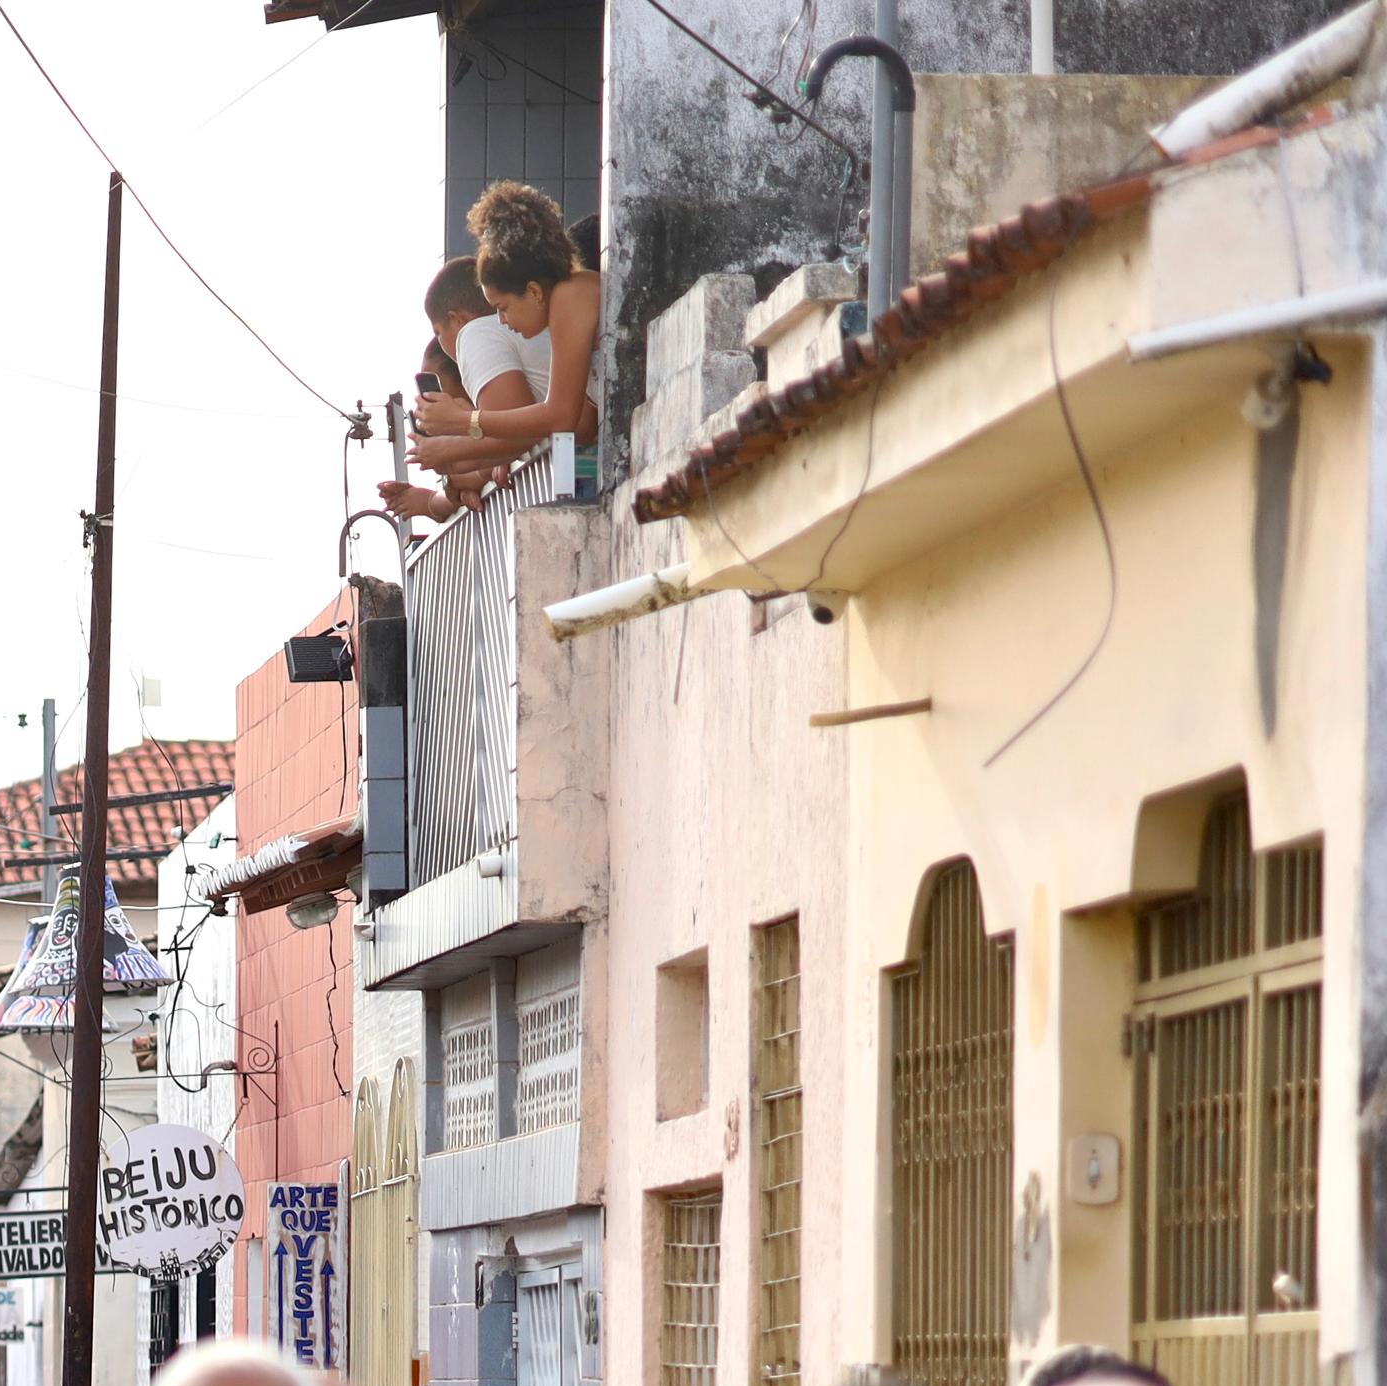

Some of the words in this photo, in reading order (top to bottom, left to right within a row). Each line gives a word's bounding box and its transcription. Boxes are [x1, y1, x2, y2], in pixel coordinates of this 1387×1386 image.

[102, 1144, 217, 1205] BEIJU
[269, 1186, 338, 1208] ARTE
[98, 1193, 244, 1246] HISTÓRICO
[280, 1209, 331, 1233] QUE
[291, 1234, 318, 1366] VESTE
